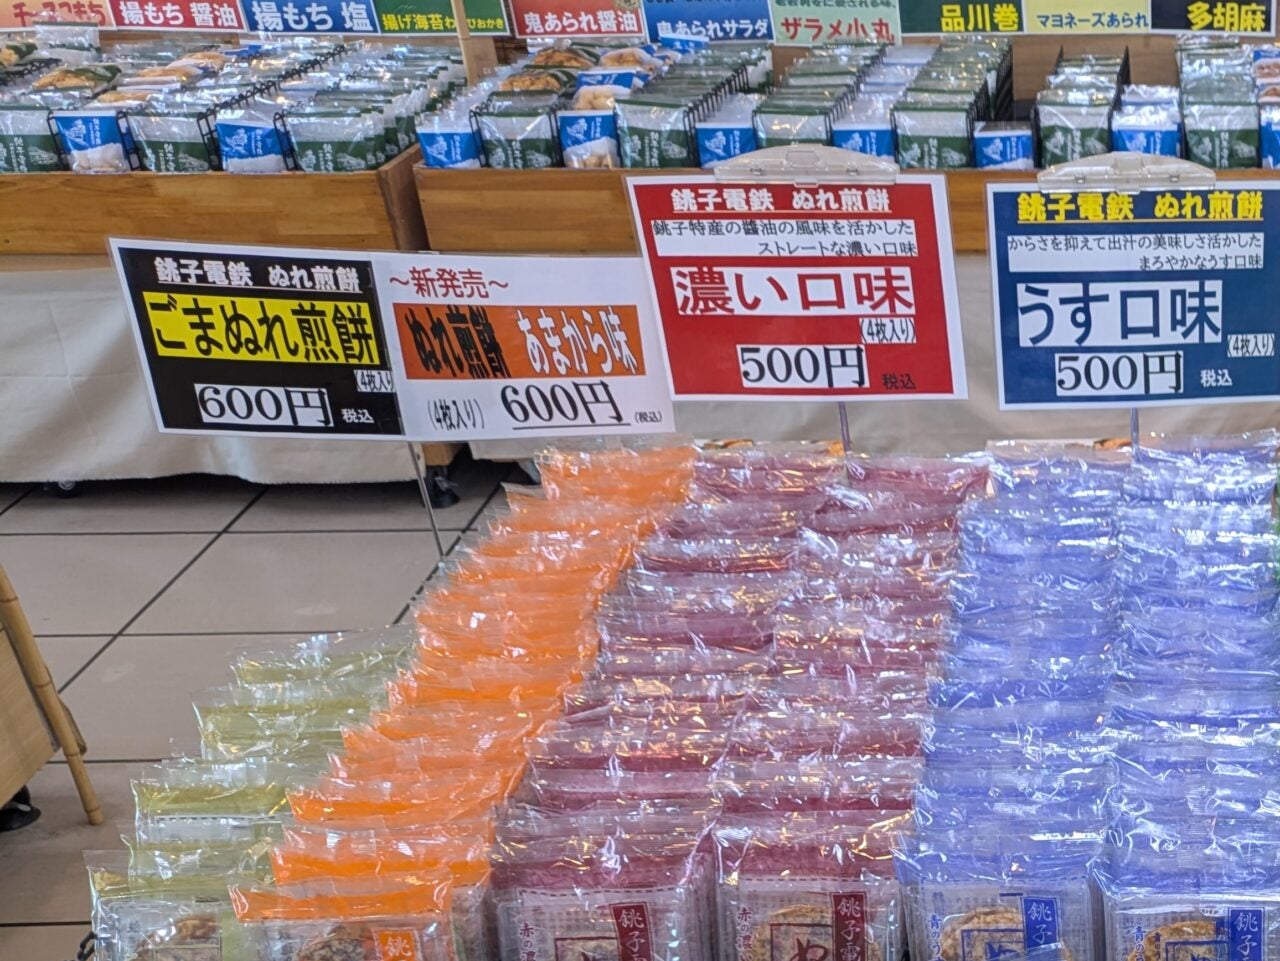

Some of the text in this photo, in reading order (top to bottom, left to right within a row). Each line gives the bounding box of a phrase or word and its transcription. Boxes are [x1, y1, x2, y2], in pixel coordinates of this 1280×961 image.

[119, 2, 185, 25] 揚もち
[191, 3, 238, 28] 醤油
[250, 1, 372, 31] 揚もち 塩
[382, 13, 504, 31] 揚げ海苔わびおかき
[524, 10, 638, 34] 鬼あられ醤油
[940, 3, 1020, 32] 品川巻
[1036, 11, 1148, 29] マヨネーズあられ
[1186, 2, 1265, 32] 多胡麻
[780, 17, 894, 42] ザラメ小丸
[671, 189, 890, 212] 銚子電鉄 ぬれ煎餅
[1017, 191, 1264, 222] 銚子電鉄 ぬれ煎餅
[758, 240, 917, 257] ストレートな濃い口味
[1009, 234, 1262, 251] からさを抑えて出汁の美味しさ活かした
[154, 256, 360, 292] 銚子電鉄 ぬれ煎餅
[1138, 254, 1263, 271] まろやかなうす口味
[675, 266, 914, 315] 濃い口味
[1018, 281, 1221, 346] うす口味
[149, 293, 375, 364] ごまぬれ煎餅
[405, 304, 640, 379] ぬれ煎餅 あまから味
[860, 318, 916, 343] (4枚入り)
[1227, 335, 1275, 356] (4枚入り)
[354, 369, 395, 393] (4枚入り)
[740, 345, 916, 390] 500円 税込
[1057, 352, 1233, 394] 500円 税込
[199, 386, 332, 427] 600円
[341, 408, 374, 424] 税込
[428, 380, 663, 431] (4枚入り) 600円 (税込)
